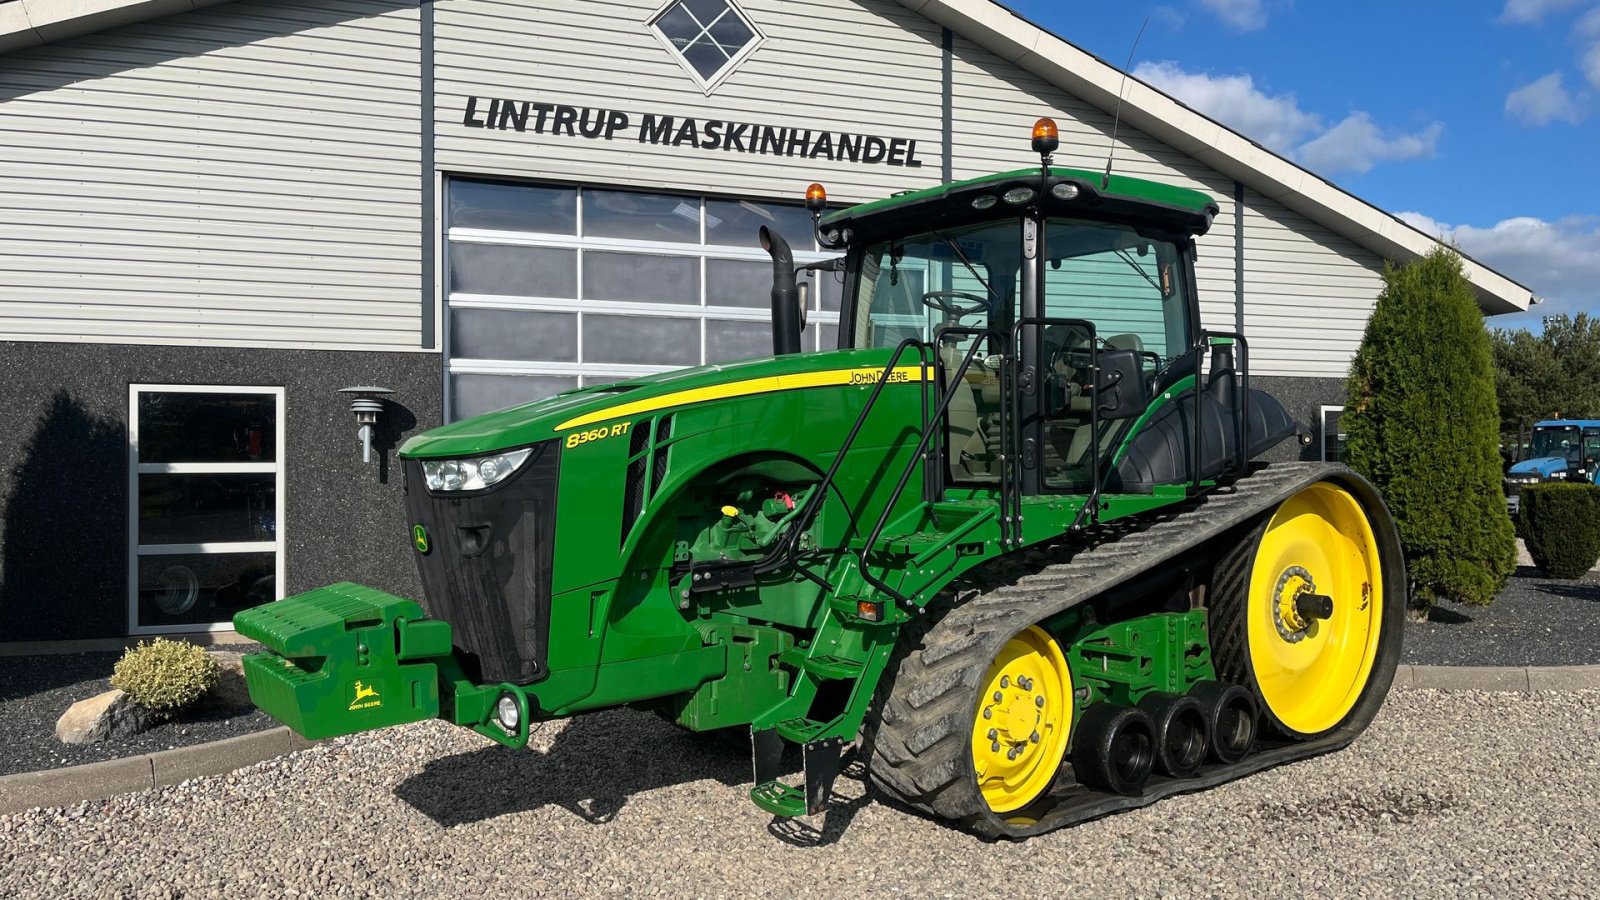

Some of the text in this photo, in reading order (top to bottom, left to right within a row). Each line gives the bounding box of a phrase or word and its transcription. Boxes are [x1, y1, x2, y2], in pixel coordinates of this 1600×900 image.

[463, 95, 924, 168] LINTRUP MASKINHANDEL
[876, 370, 909, 382] DERE
[566, 421, 632, 449] 8360 RT
